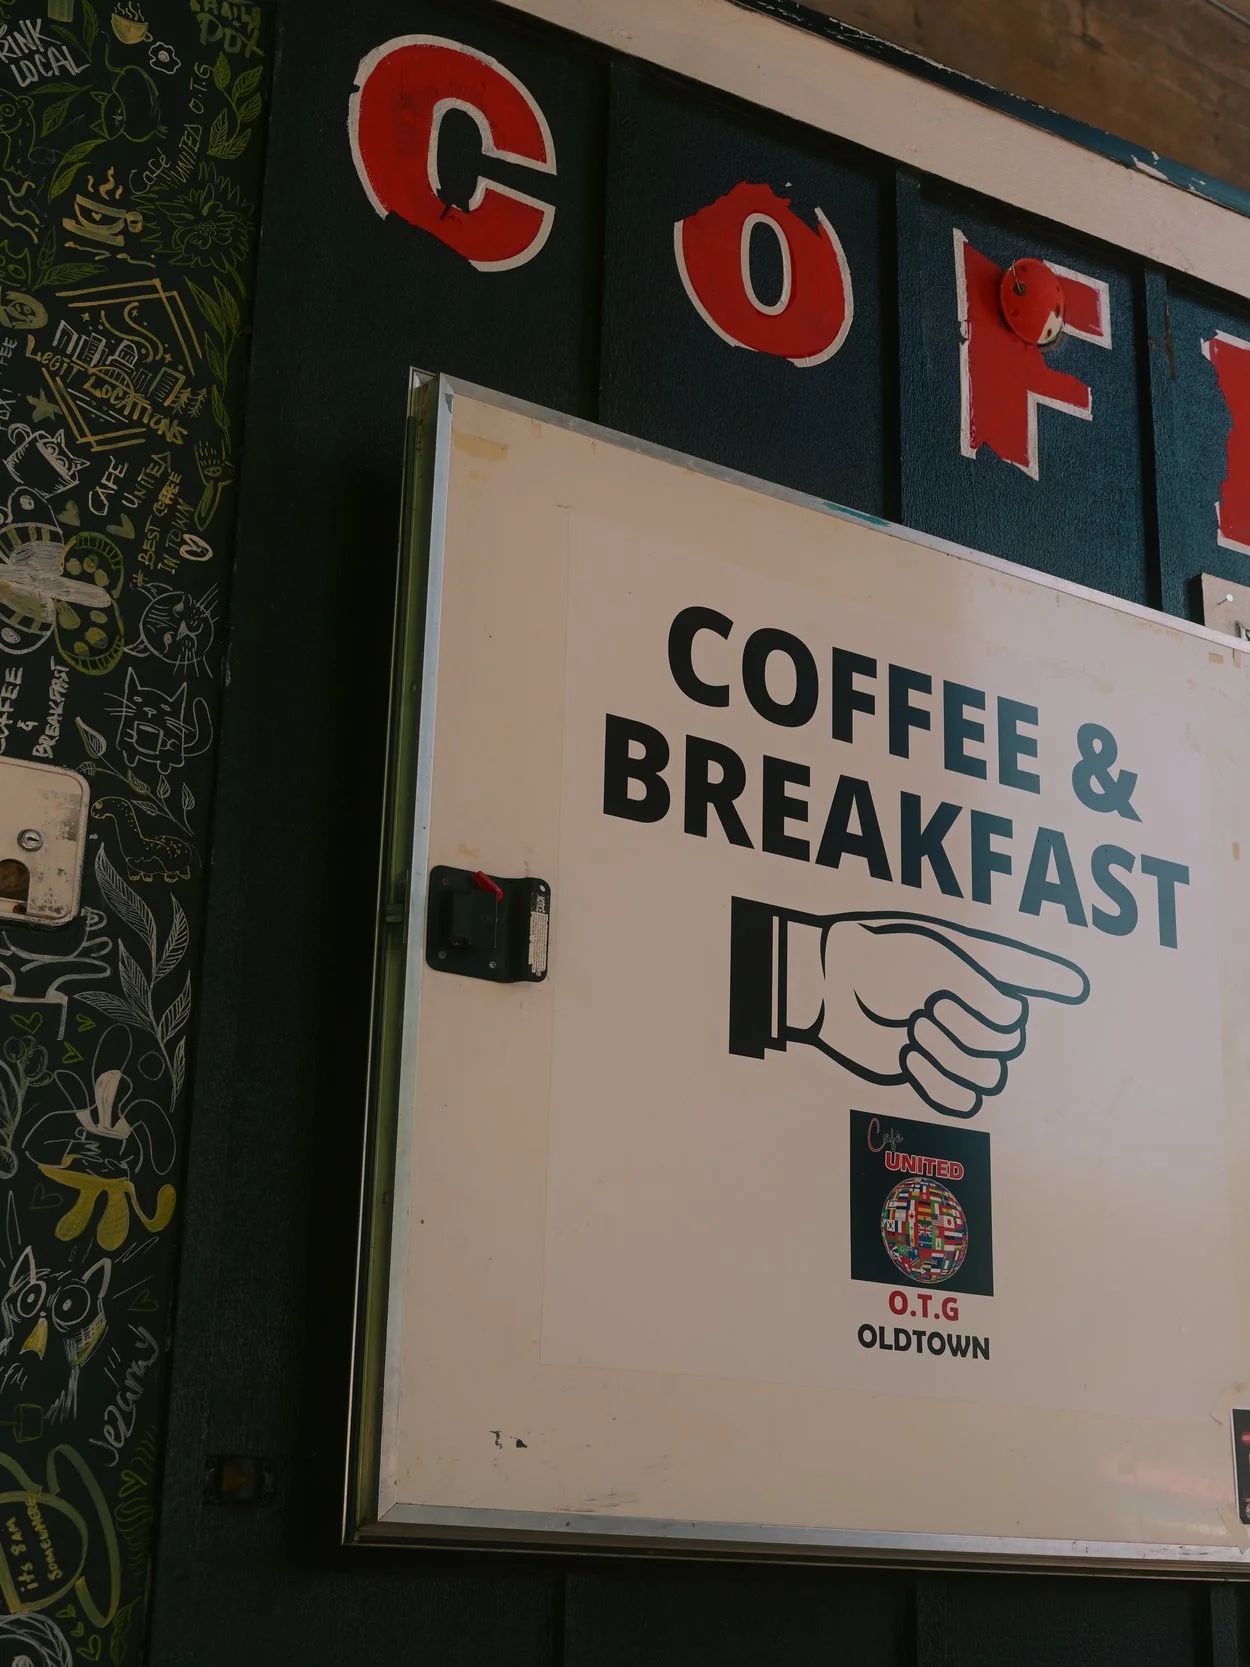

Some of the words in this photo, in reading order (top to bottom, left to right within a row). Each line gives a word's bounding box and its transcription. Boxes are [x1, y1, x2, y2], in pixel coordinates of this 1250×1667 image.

[0, 18, 62, 63] RINK
[10, 45, 92, 88] LOCAL
[83, 374, 189, 446] LOCATIONS
[88, 455, 130, 516] CAFE
[122, 451, 172, 508] UNITED
[137, 515, 161, 570] BEST
[165, 497, 195, 550] TOWN
[666, 605, 1041, 796] COFFEE
[1071, 722, 1143, 824] &
[602, 712, 1191, 950] BREAKFAST
[884, 1150, 965, 1181] UNITED
[888, 1290, 959, 1322] O.T.G
[857, 1323, 990, 1361] OLDTOWN
